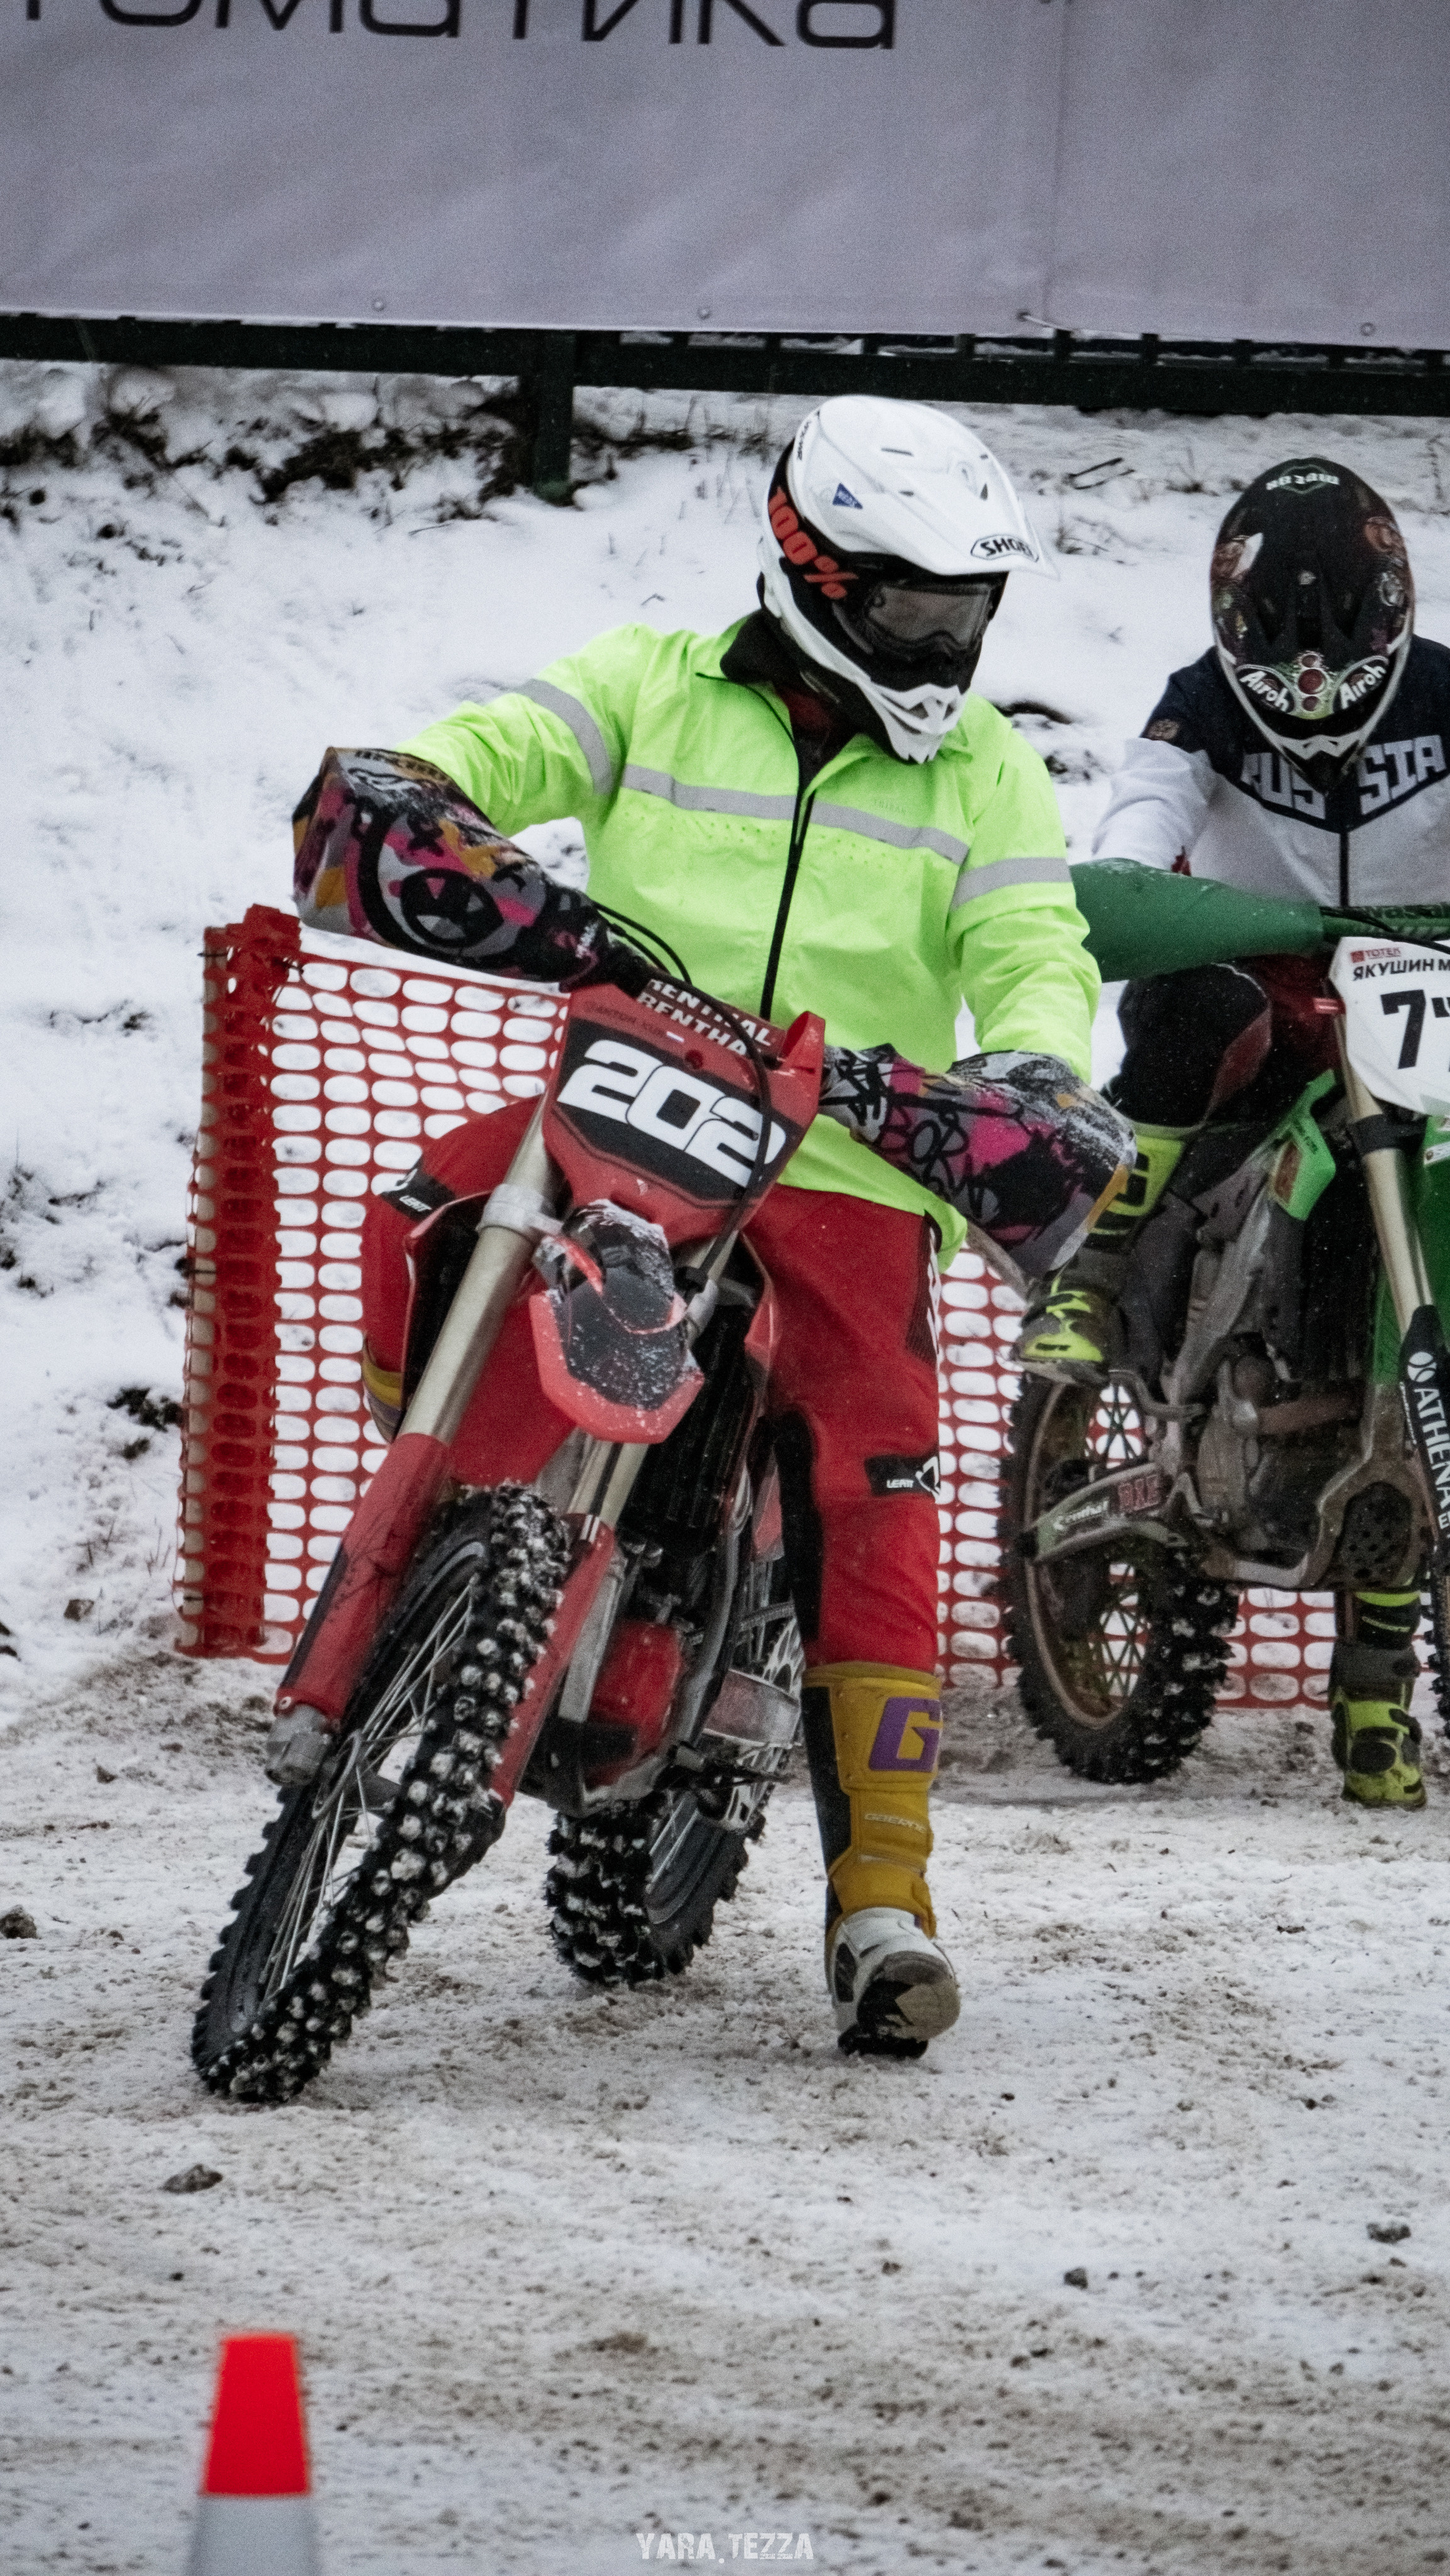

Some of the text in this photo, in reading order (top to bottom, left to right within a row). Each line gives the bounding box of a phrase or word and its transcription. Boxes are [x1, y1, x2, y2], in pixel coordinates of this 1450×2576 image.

[1239, 670, 1290, 712] Airoh
[1339, 664, 1386, 709] Airoh
[1352, 958, 1434, 981] ЯКУШИН
[637, 992, 762, 1056] RENTHA
[557, 1039, 786, 1187] 202
